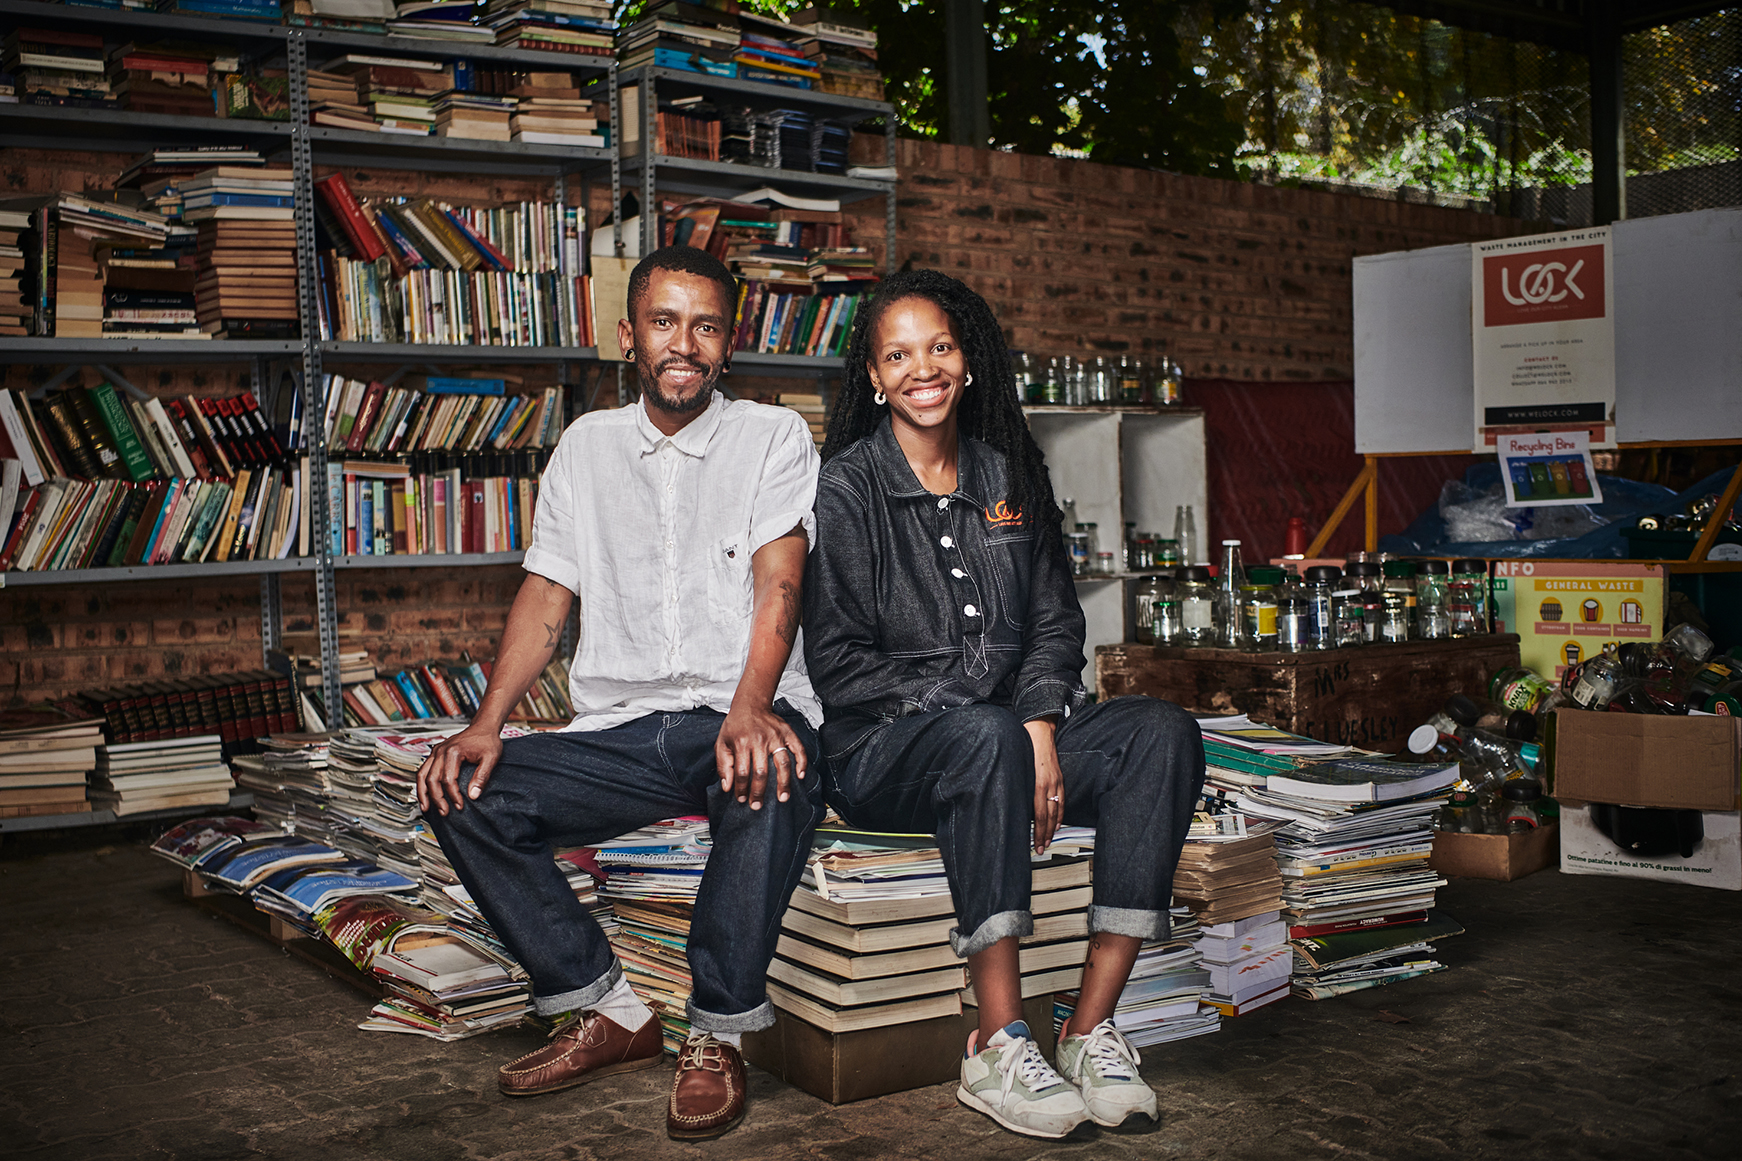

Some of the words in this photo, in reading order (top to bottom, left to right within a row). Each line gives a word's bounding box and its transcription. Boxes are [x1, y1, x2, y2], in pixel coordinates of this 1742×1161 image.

[1507, 237, 1556, 248] MANAGEMENT
[1588, 231, 1606, 239] CITY
[1507, 410, 1579, 418] WWW.WELOCK.COM
[1510, 440, 1553, 456] Recycling
[1556, 438, 1575, 450] Bins
[1545, 581, 1593, 590] GENERAL
[1598, 581, 1635, 590] WASTE
[1315, 661, 1350, 698] MRS
[1508, 684, 1527, 708] KNAX
[1567, 854, 1587, 863] Ottime
[1587, 857, 1613, 867] patatine
[1619, 859, 1631, 867] fino
[1639, 862, 1654, 870] 90%
